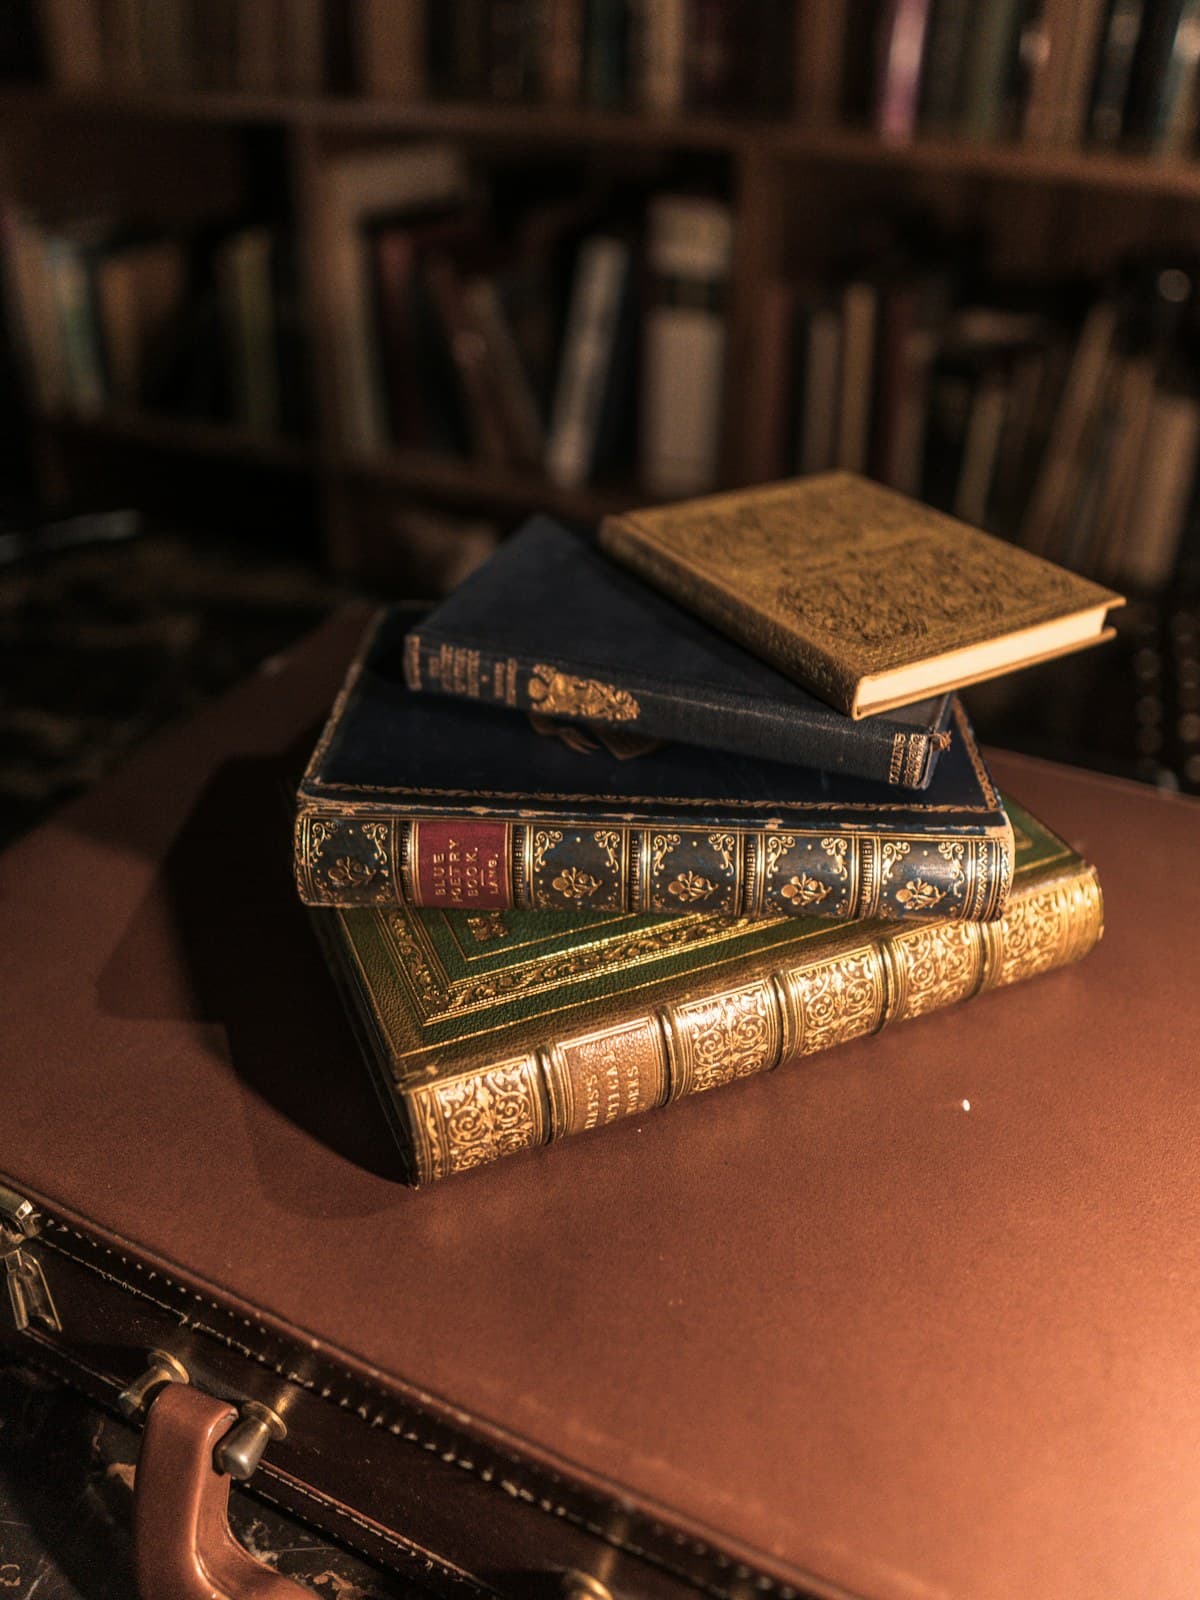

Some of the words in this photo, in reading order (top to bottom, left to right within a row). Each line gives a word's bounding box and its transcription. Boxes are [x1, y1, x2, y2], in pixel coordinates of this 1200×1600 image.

[433, 853, 446, 896] BLUE
[448, 838, 463, 903] POETRY
[465, 847, 479, 897] BOOK.
